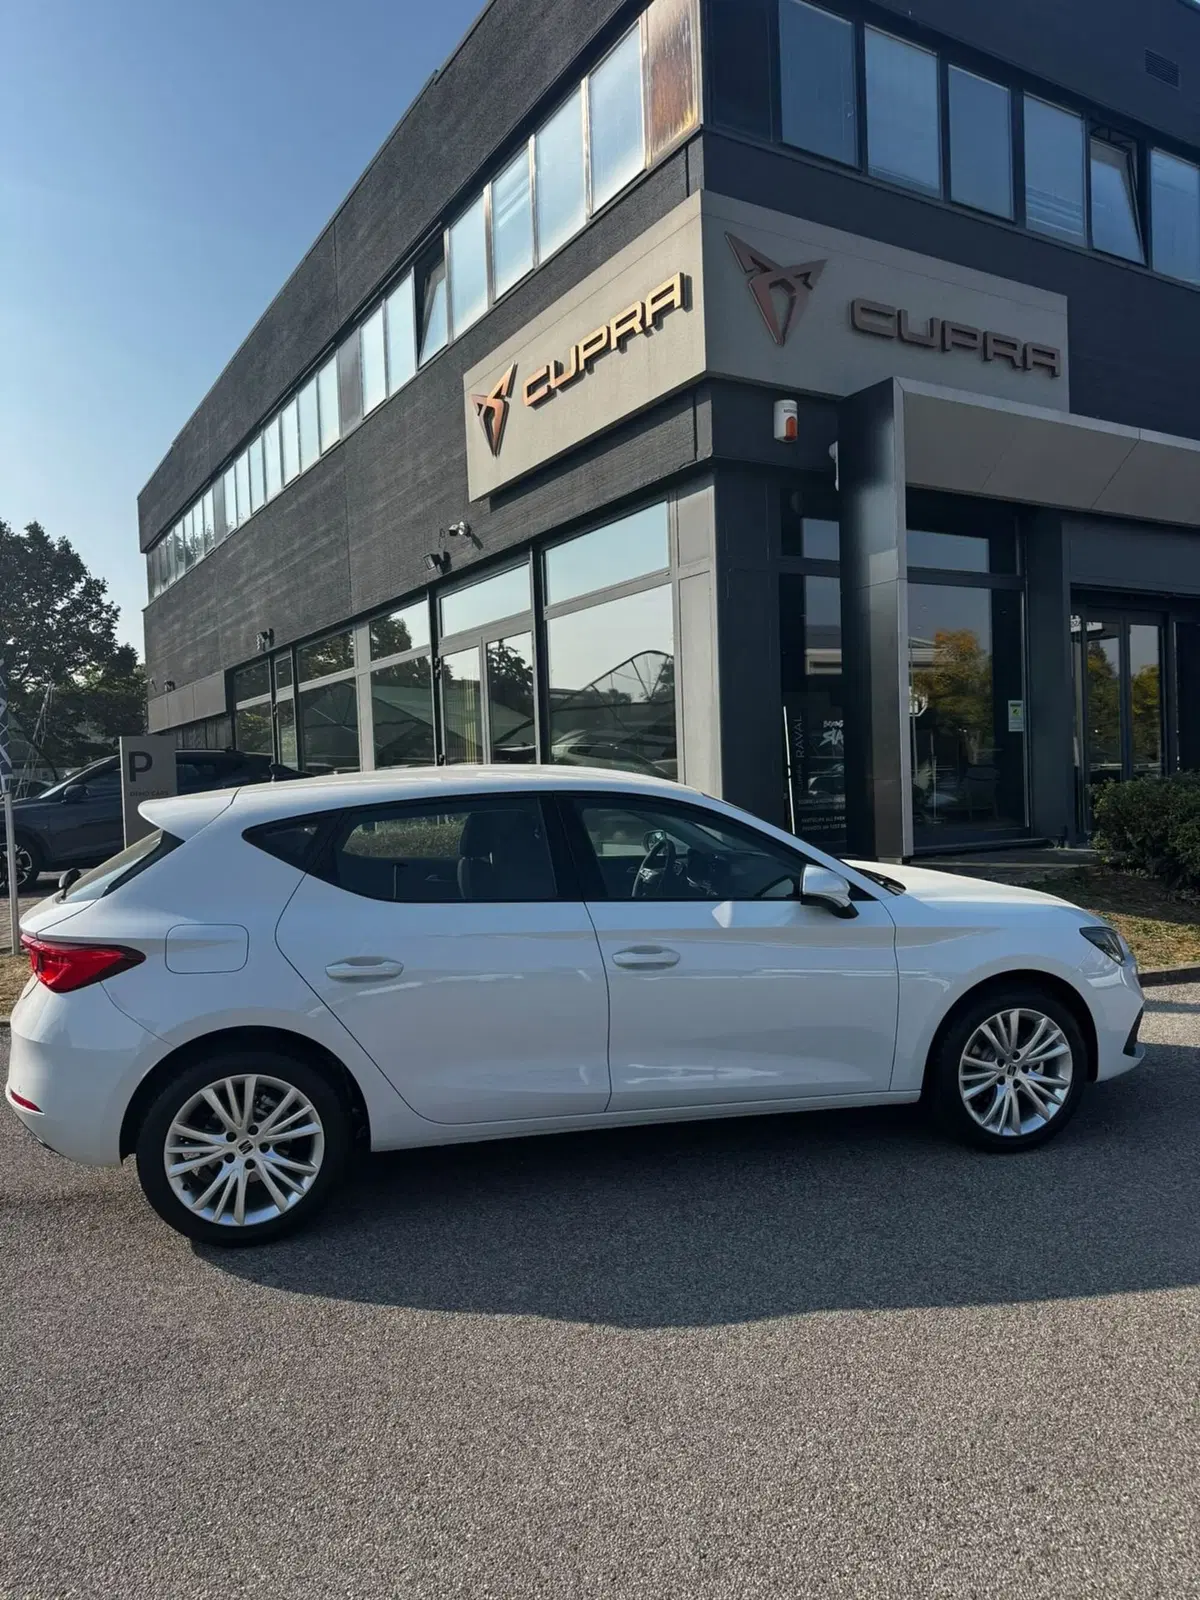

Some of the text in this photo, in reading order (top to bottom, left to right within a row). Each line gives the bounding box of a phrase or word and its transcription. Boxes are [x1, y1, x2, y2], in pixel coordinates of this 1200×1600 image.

[522, 271, 686, 408] CUPRA
[850, 298, 1060, 377] CUPRA
[128, 751, 153, 782] P
[793, 715, 805, 758] RAVAL
